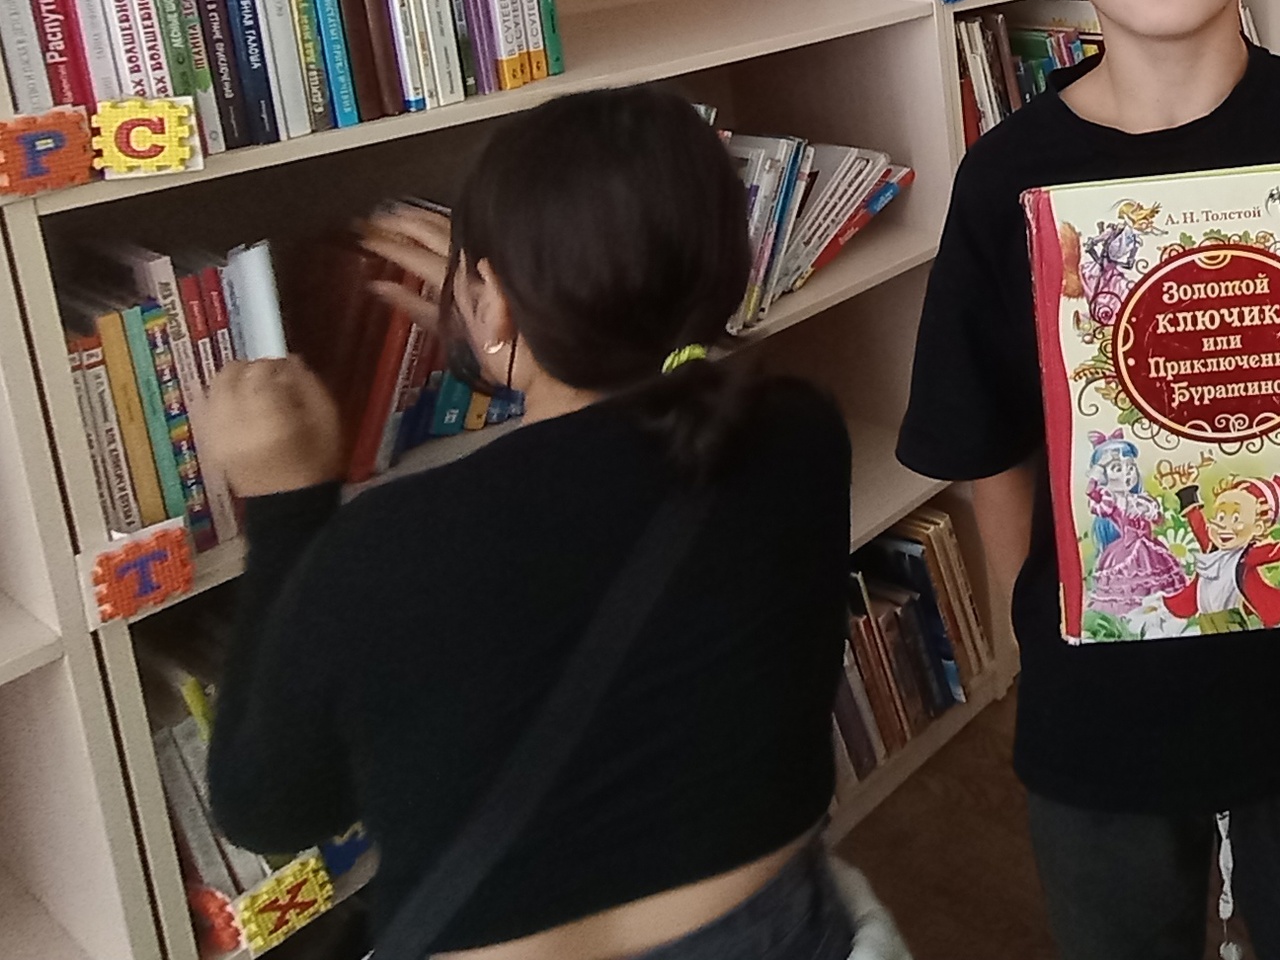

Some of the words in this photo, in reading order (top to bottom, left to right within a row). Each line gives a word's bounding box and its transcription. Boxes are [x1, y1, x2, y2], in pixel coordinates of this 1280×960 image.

[208, 11, 222, 40] СТРАНЕ
[245, 29, 262, 69] ГАЛОША
[16, 129, 67, 178] Р
[114, 117, 166, 160] С
[1164, 213, 1179, 226] А.
[1182, 211, 1199, 225] Н.
[1202, 206, 1262, 222] Толстой
[1162, 272, 1270, 306] Золотой
[1201, 335, 1243, 352] или
[115, 550, 169, 597] Т
